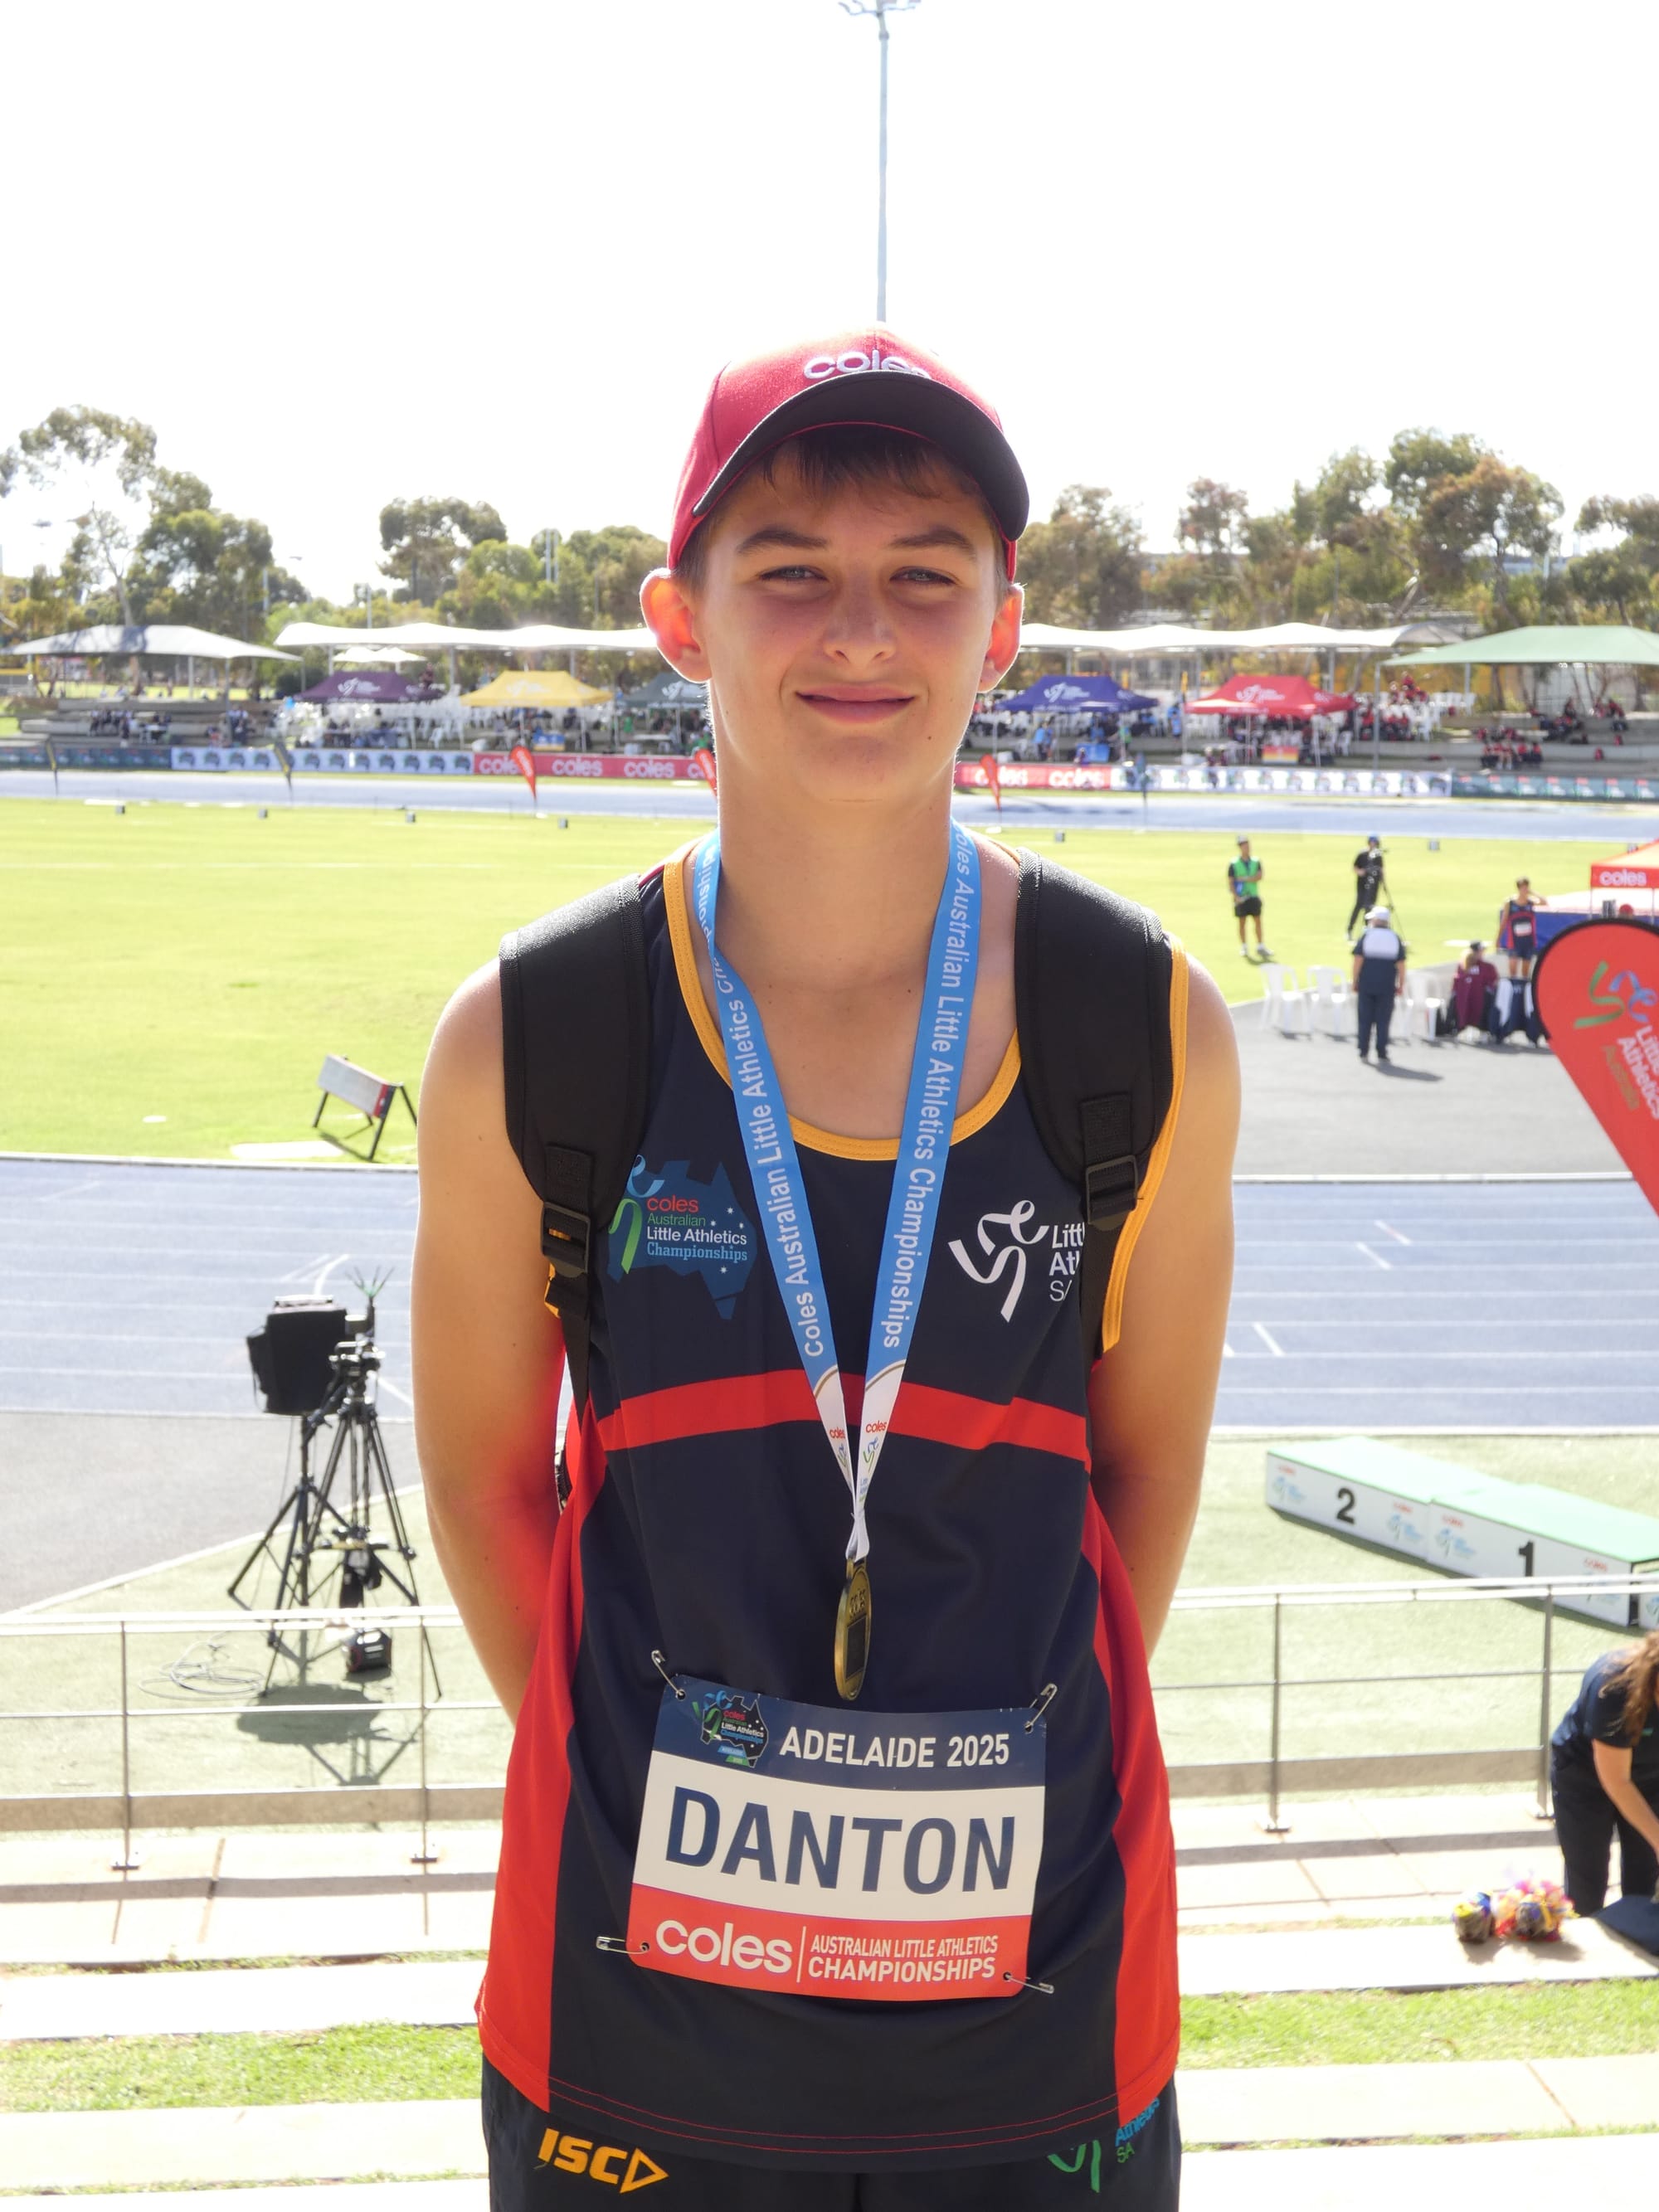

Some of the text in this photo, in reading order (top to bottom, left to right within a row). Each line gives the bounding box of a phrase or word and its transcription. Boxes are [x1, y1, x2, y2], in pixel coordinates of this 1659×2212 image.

[479, 757, 522, 774] cole
[552, 756, 603, 776] coles
[624, 760, 675, 778] coles
[1599, 868, 1647, 887] coles
[941, 878, 975, 988] Australian
[931, 995, 964, 1053] Little
[728, 999, 767, 1097] Athletics
[913, 1057, 954, 1160] Athletics
[749, 1104, 783, 1165] Little
[647, 1194, 698, 1213] coles
[648, 1213, 706, 1227] Australian
[647, 1227, 747, 1245] Little Athletics
[766, 1168, 810, 1285] Australian
[647, 1242, 747, 1263] Championships
[881, 1168, 937, 1349] Championships
[796, 1291, 824, 1357] Coles
[865, 1420, 888, 1433] coles
[1336, 1488, 1356, 1525] 2
[1517, 1540, 1535, 1577] 1
[779, 1726, 1010, 1767] ADELAIDE 2025
[665, 1786, 1016, 1895] DANTON
[655, 1919, 793, 1973] coles
[810, 1934, 999, 1958] AUSTRALIAN LITTLE ATHLETICS
[808, 1957, 996, 1982] CHAMPIONSHIPS
[538, 2127, 628, 2185] ISC
